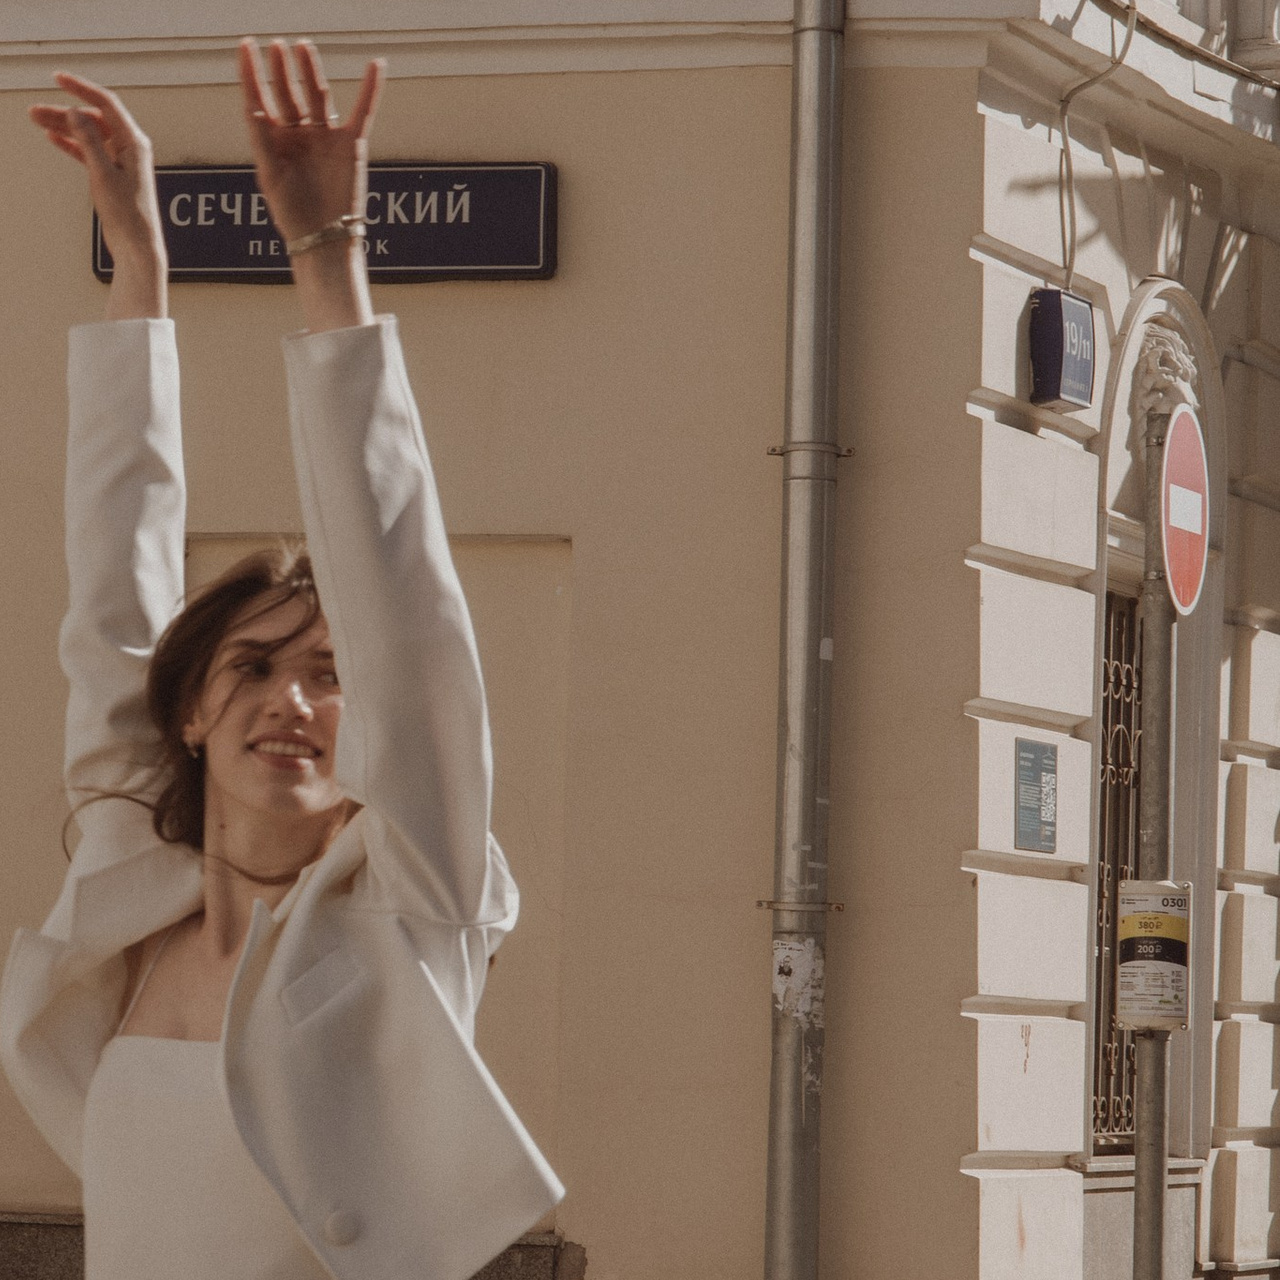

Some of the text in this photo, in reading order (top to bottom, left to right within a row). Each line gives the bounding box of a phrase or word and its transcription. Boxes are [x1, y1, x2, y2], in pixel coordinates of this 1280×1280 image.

[169, 183, 472, 226] СЕЧЕСКИЙ
[1065, 321, 1091, 360] 19/11
[1162, 897, 1187, 908] 0301
